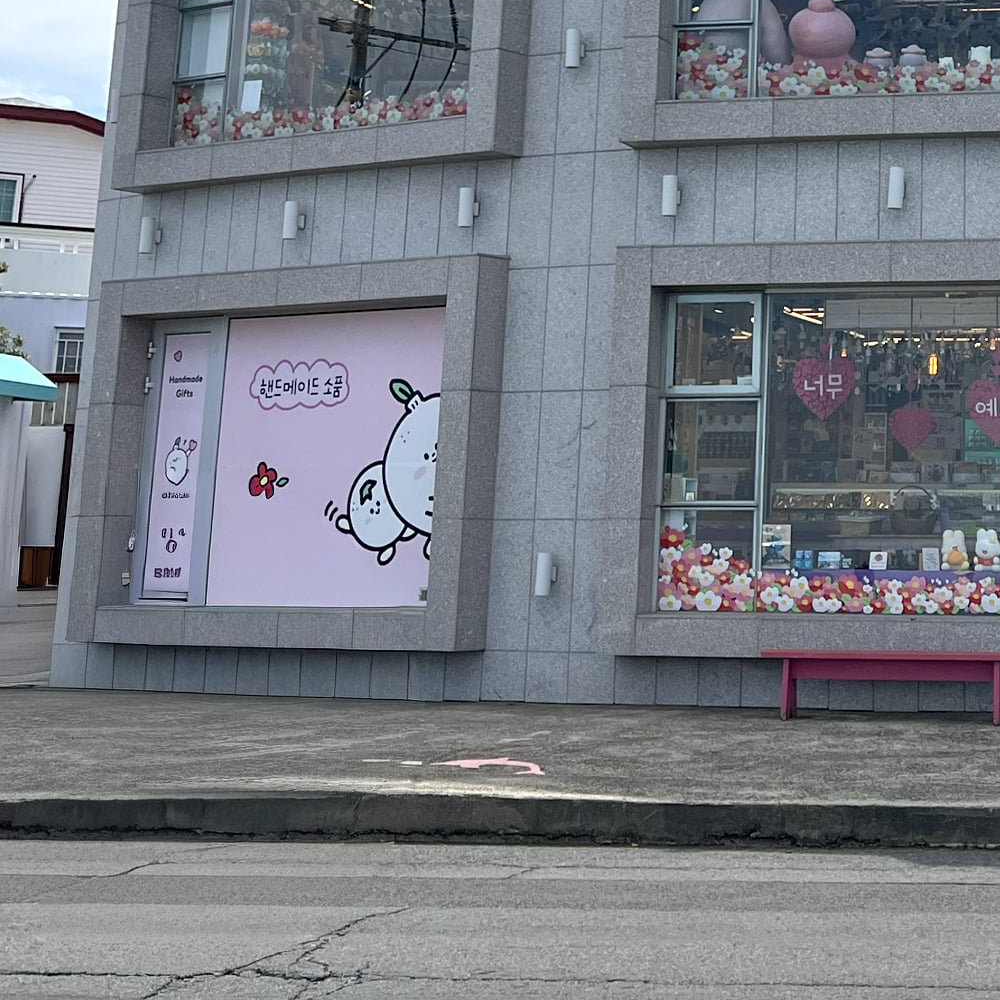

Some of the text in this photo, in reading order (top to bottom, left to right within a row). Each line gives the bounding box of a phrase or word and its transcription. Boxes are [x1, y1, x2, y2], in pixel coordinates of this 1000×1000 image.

[168, 374, 203, 385] Handmade
[259, 375, 344, 400] 핸드메이드 소품
[803, 373, 843, 401] 너무
[175, 388, 194, 399] Gifts
